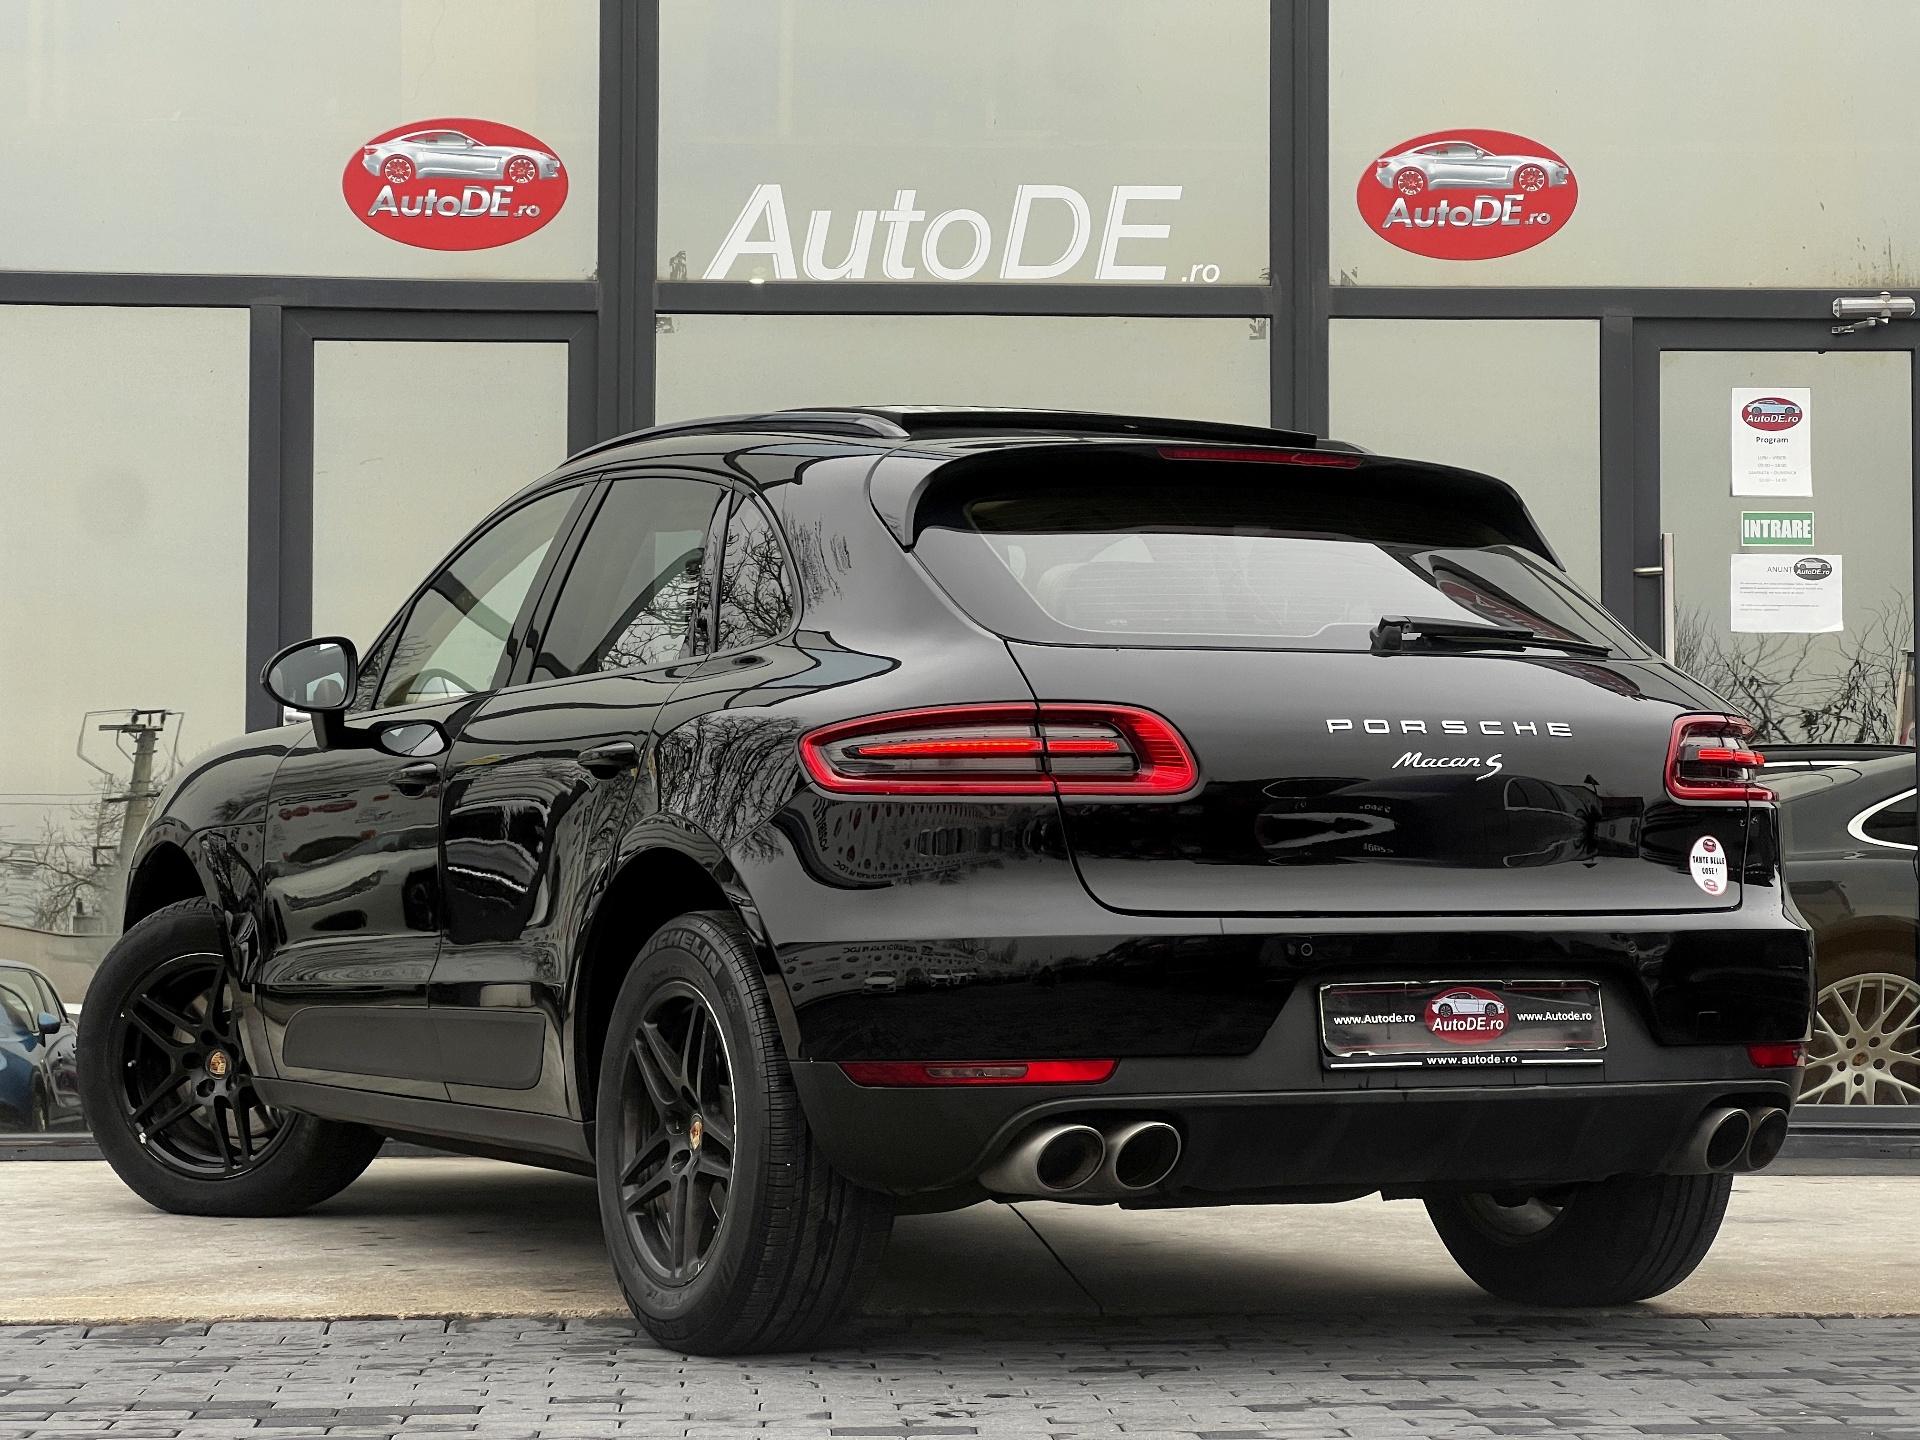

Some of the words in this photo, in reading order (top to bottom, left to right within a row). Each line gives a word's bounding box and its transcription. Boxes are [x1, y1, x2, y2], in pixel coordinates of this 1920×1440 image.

[1746, 413, 1799, 423] AutoDE.ro
[1755, 436, 1789, 445] Program
[1744, 519, 1812, 538] INTRARE
[1326, 718, 1573, 737] PORSCHE
[1391, 751, 1481, 769] Macan
[1476, 753, 1503, 781] S
[1334, 1012, 1416, 1025] www.Autode.ro
[1517, 1010, 1592, 1022] www.Autode.ro
[1431, 1017, 1505, 1032] AutoDE.ro
[1426, 1054, 1518, 1065] www.autode.ro
